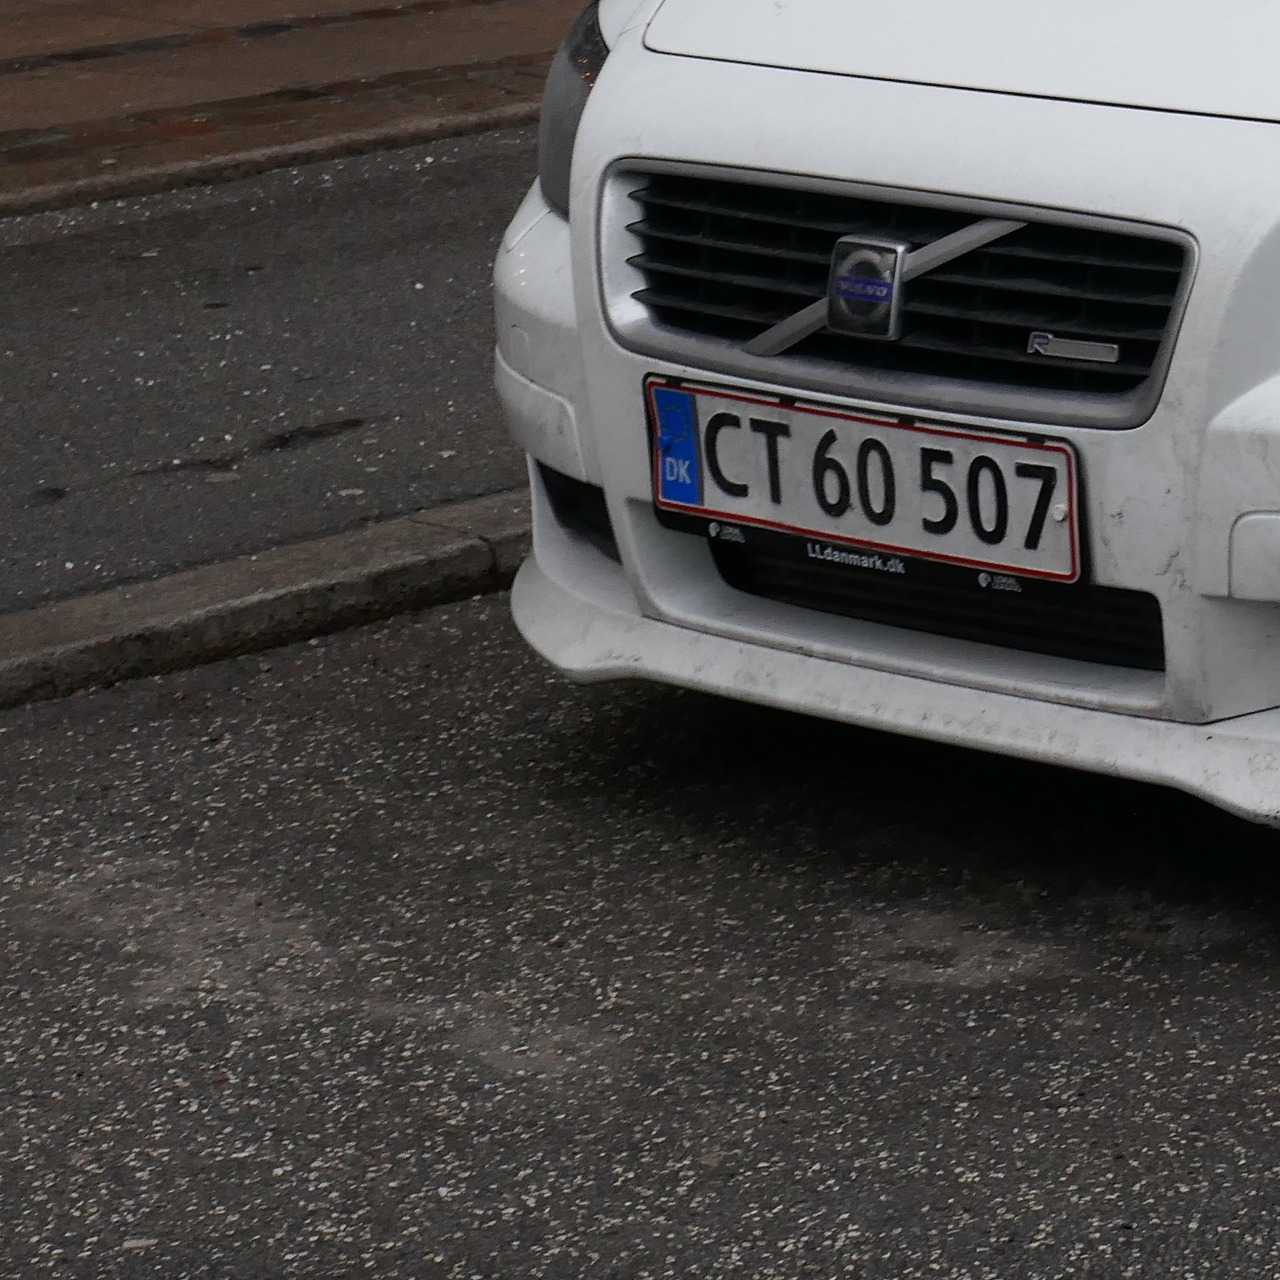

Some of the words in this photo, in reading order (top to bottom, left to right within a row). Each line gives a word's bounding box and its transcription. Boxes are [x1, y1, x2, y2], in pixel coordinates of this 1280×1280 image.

[666, 458, 693, 485] DK
[704, 412, 791, 505] CT
[812, 428, 896, 526] 60
[920, 447, 1058, 551] 507
[806, 542, 906, 575] LLdanmark.dk
